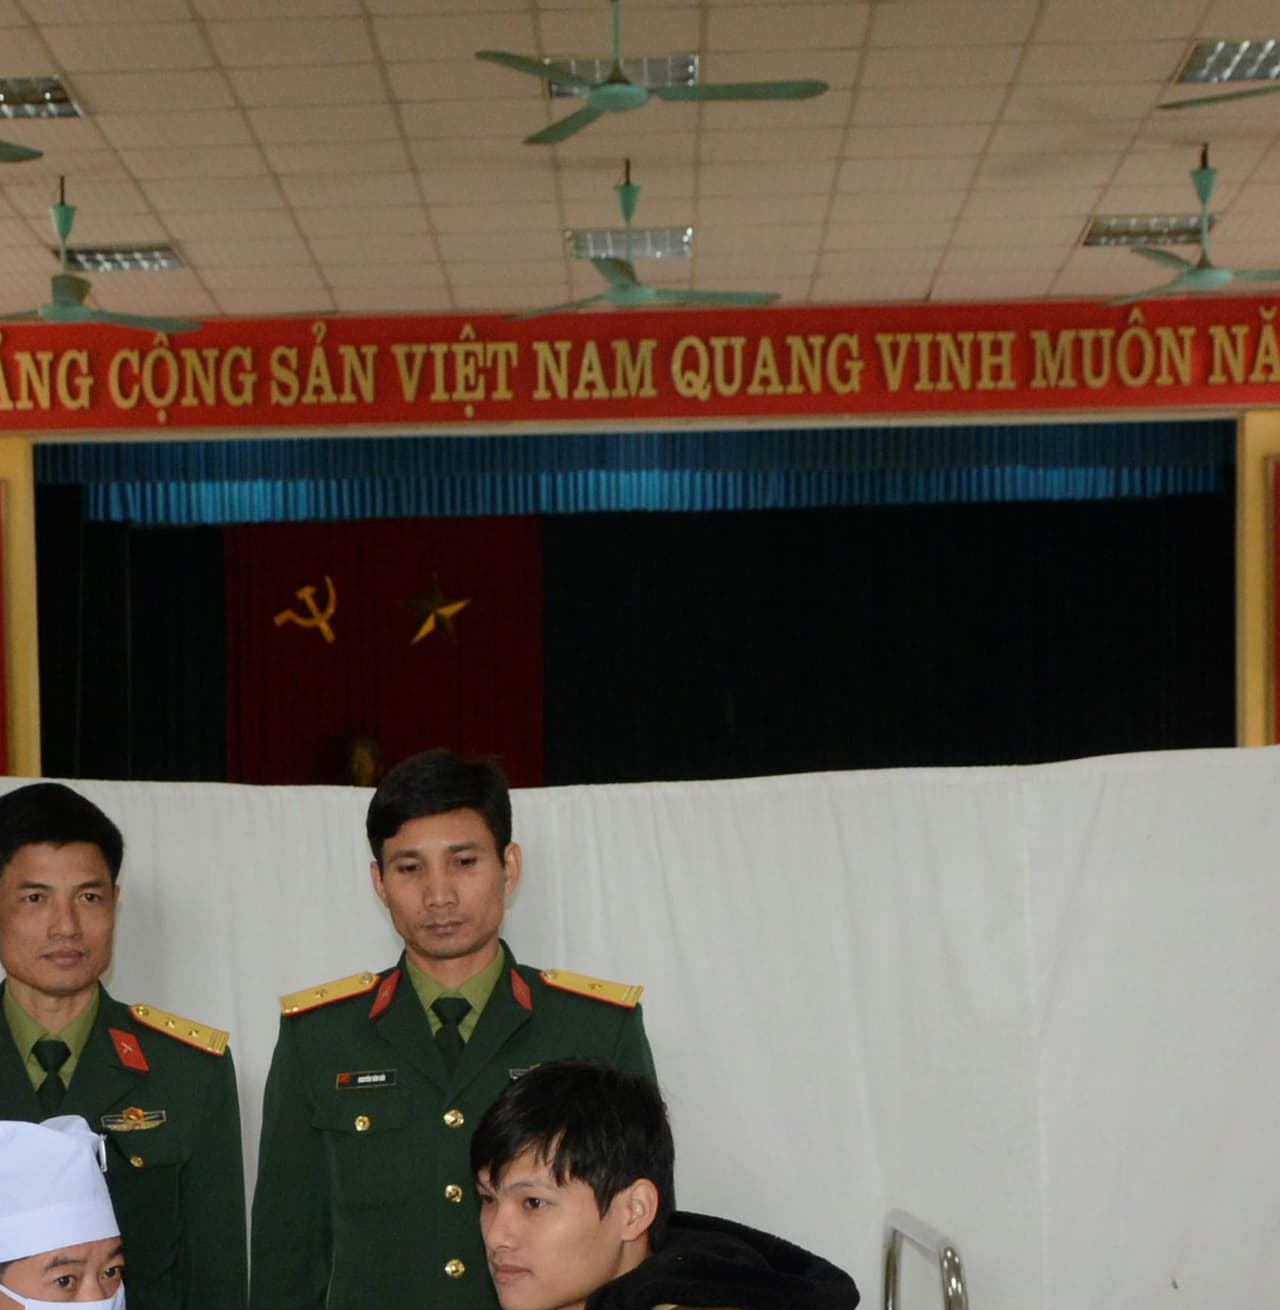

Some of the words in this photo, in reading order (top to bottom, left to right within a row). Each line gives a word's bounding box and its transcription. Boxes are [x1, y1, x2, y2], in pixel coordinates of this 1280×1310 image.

[109, 331, 256, 424] CỘNG
[270, 322, 378, 406] SẢN
[392, 324, 519, 418] VIỆT
[533, 339, 658, 399] NAM
[670, 334, 865, 400] QUANG
[875, 331, 1017, 393] VINH
[1031, 308, 1197, 389] MUÔN
